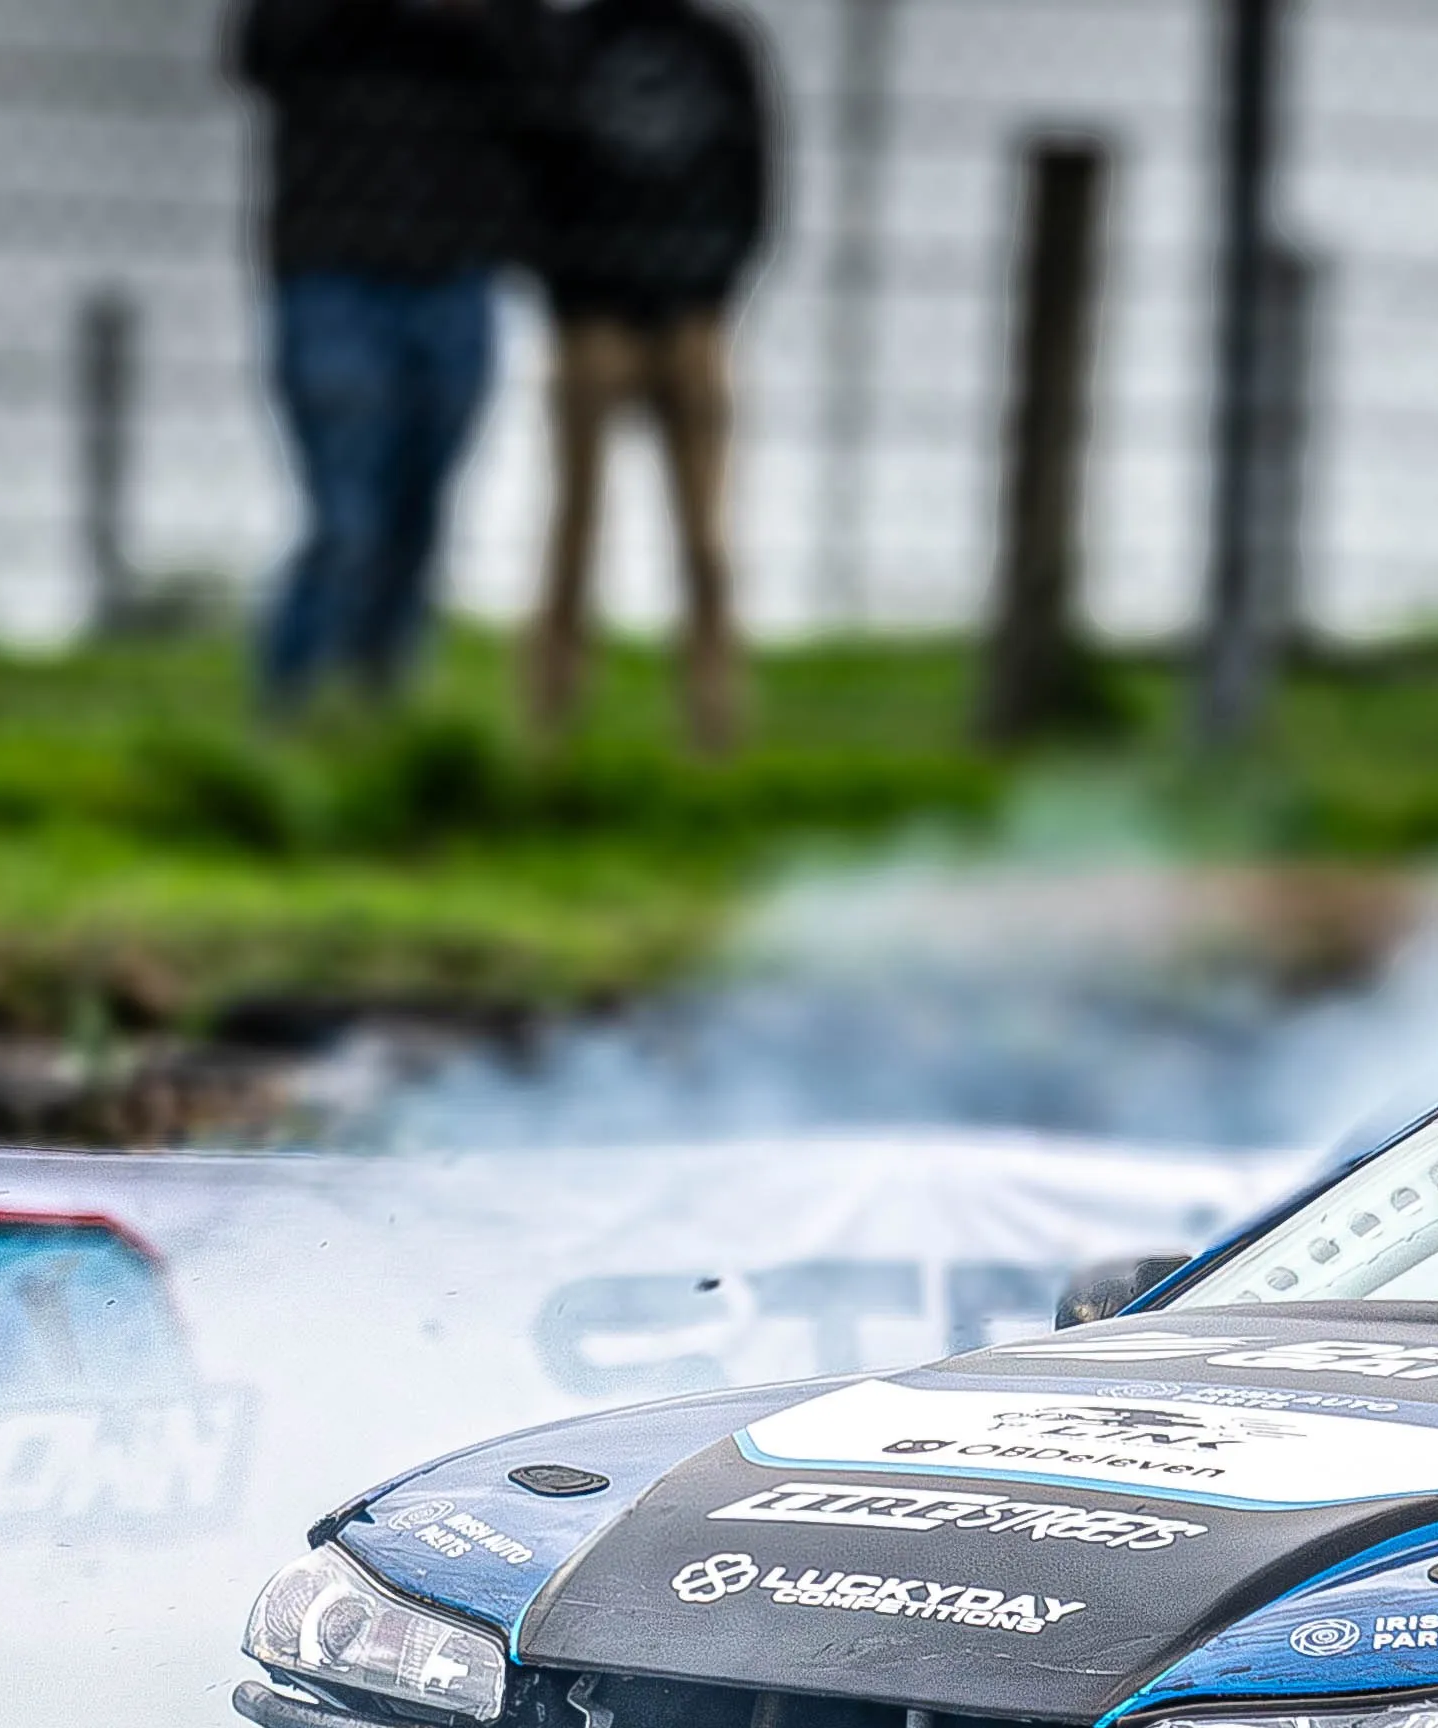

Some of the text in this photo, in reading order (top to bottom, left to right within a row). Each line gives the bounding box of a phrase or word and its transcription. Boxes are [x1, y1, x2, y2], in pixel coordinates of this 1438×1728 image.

[957, 1443, 1226, 1479] OBDeleven
[760, 1565, 1086, 1625] LUCKYDAY
[772, 1587, 1048, 1635] COMPETITIONS
